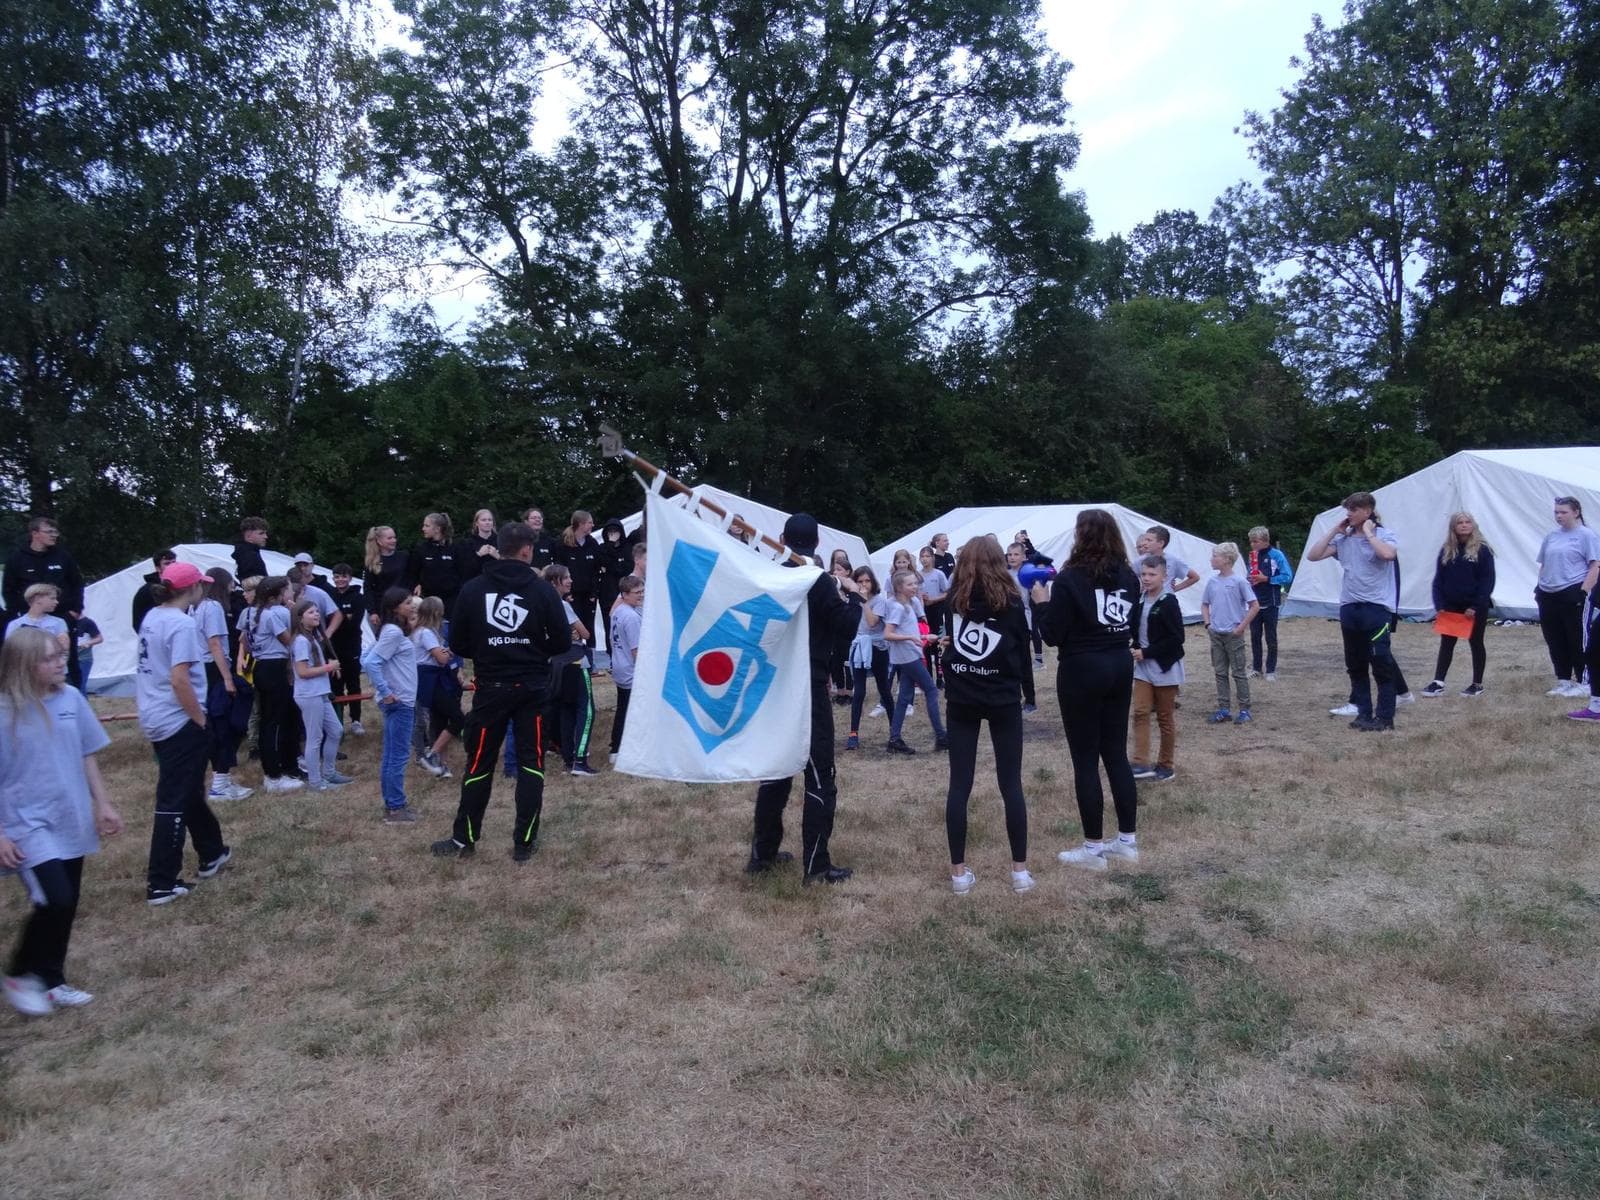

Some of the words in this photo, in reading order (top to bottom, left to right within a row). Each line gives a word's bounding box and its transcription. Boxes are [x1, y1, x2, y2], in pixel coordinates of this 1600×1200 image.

[488, 637, 503, 646] KjG
[504, 637, 531, 645] Dalum
[951, 663, 967, 673] KjG
[969, 665, 999, 675] Dalum
